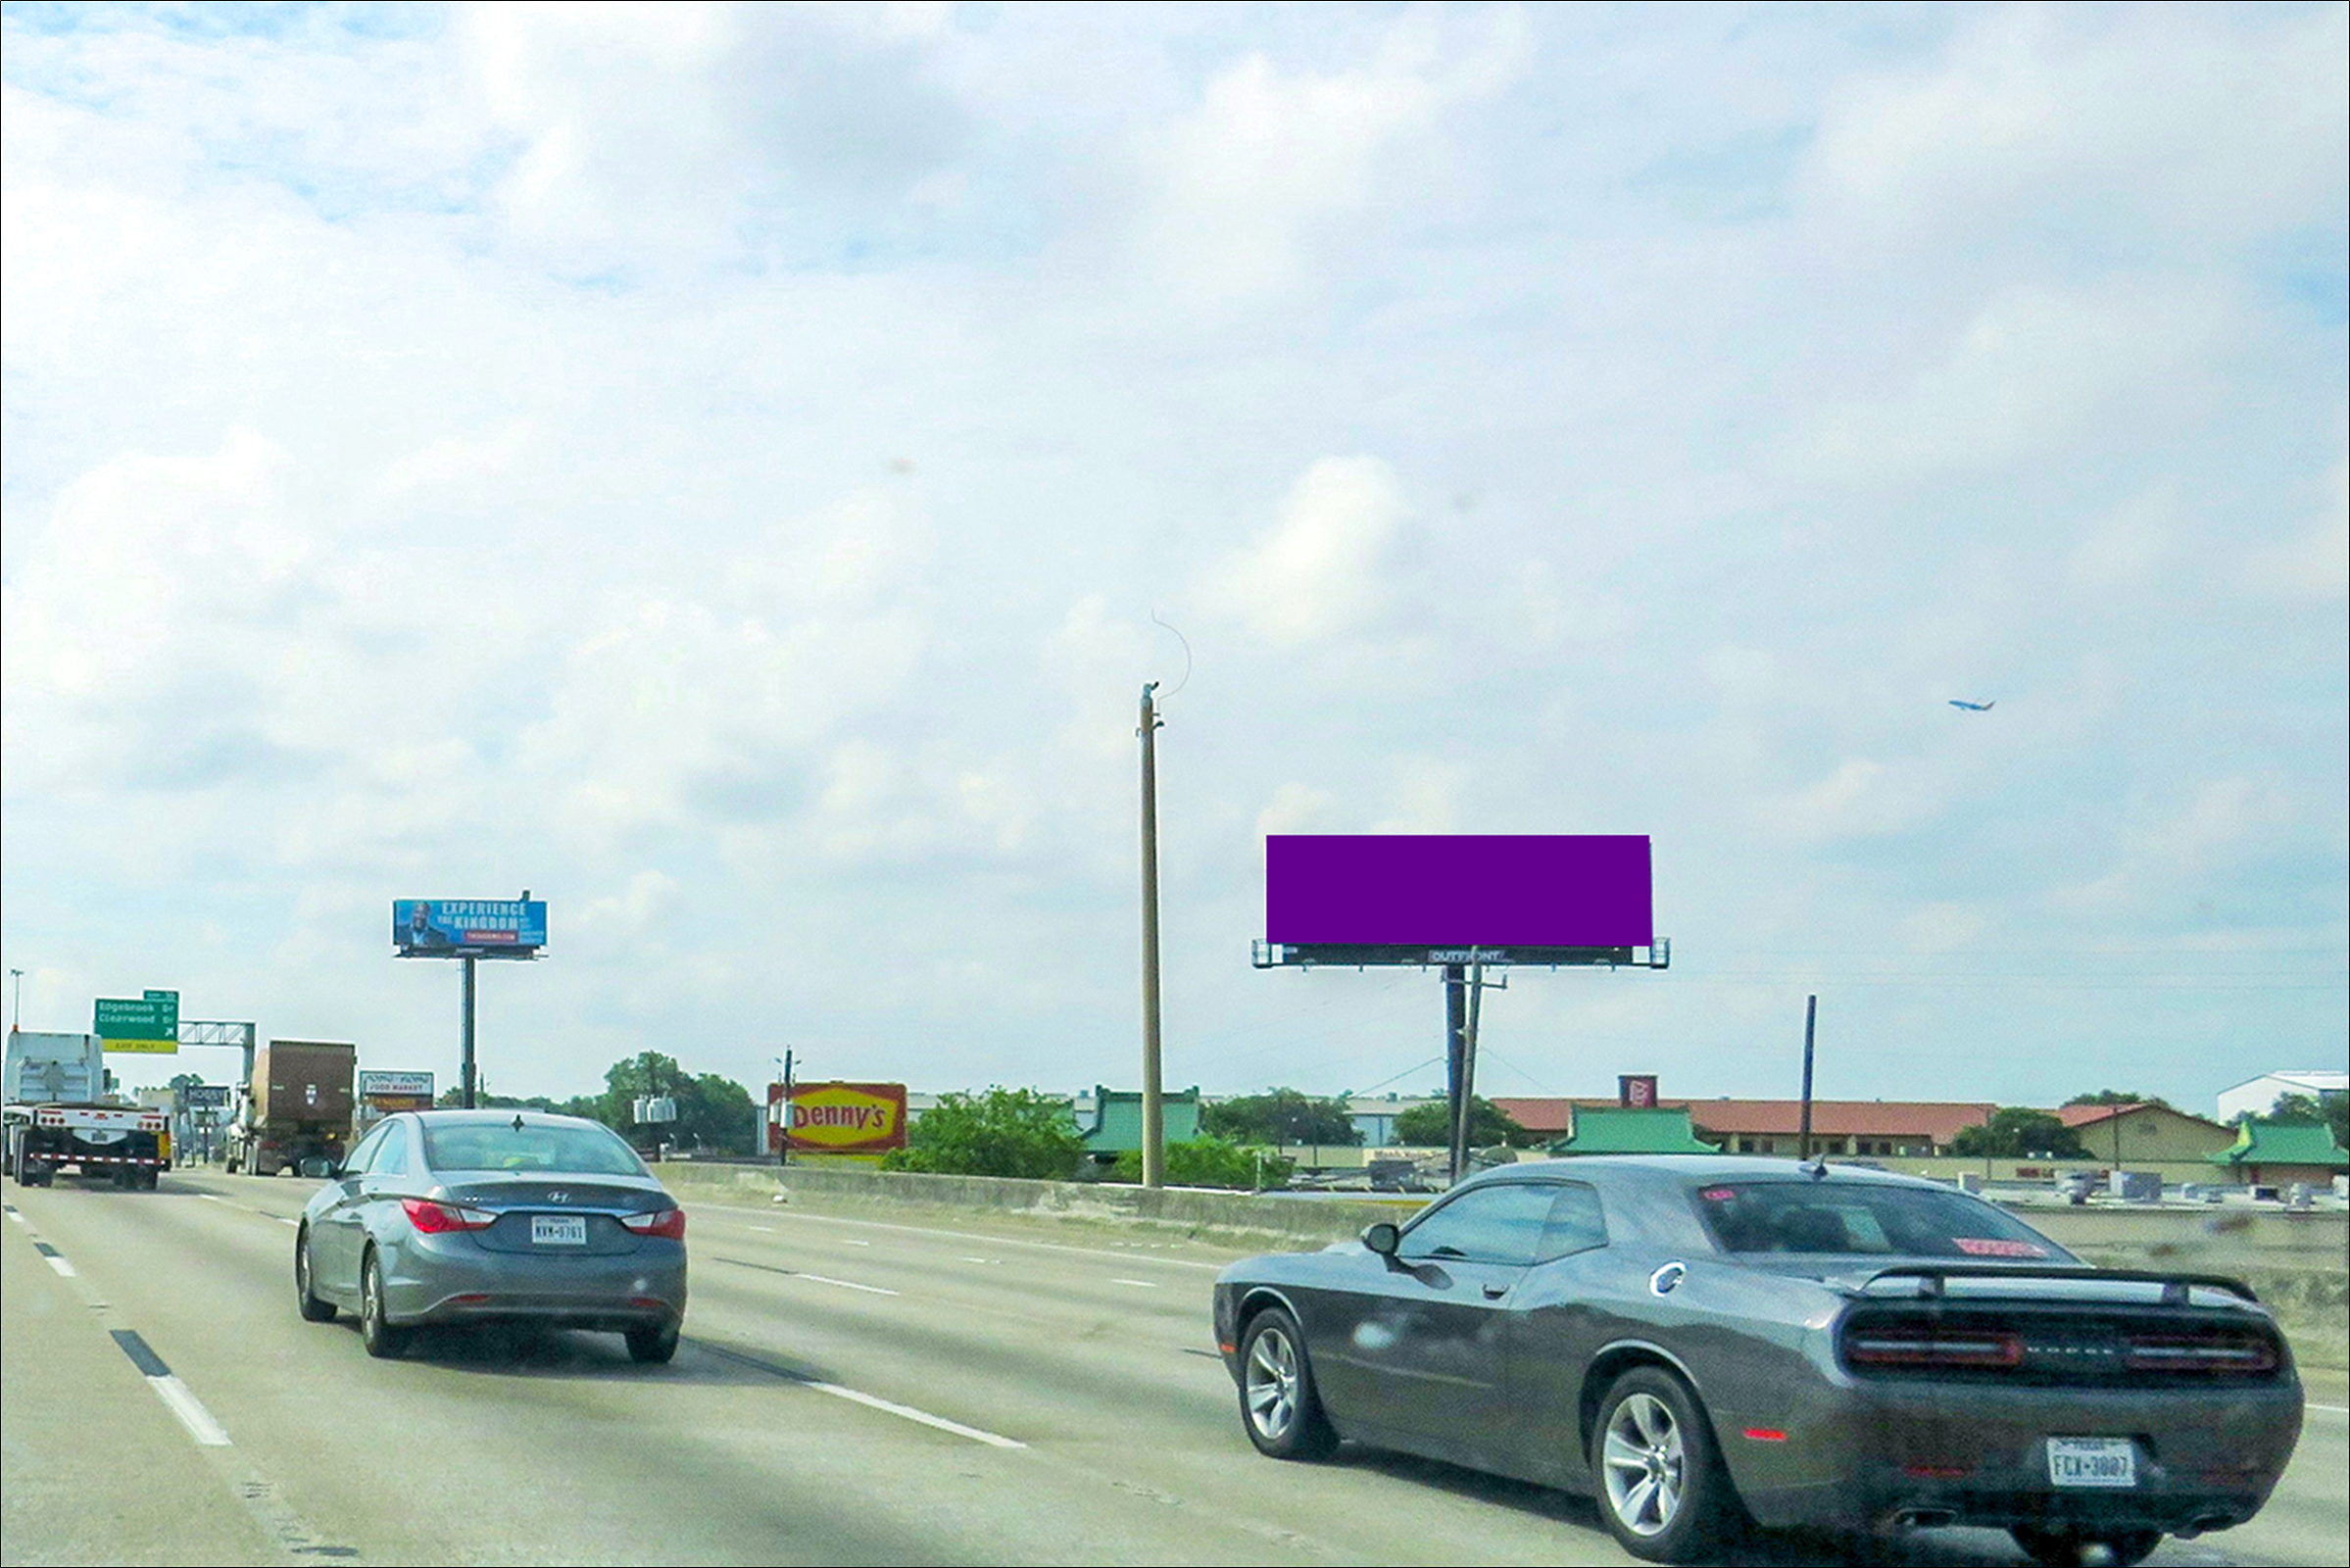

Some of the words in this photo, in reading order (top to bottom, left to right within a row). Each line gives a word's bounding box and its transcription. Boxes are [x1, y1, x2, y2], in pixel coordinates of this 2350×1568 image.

[442, 902, 527, 916] EXPERIENCE
[454, 915, 519, 930] KINGDOM
[98, 1002, 155, 1013] Edgebrook
[162, 1003, 174, 1013] Dr
[98, 1013, 156, 1024] Clearwood
[794, 1103, 886, 1130] Denny's
